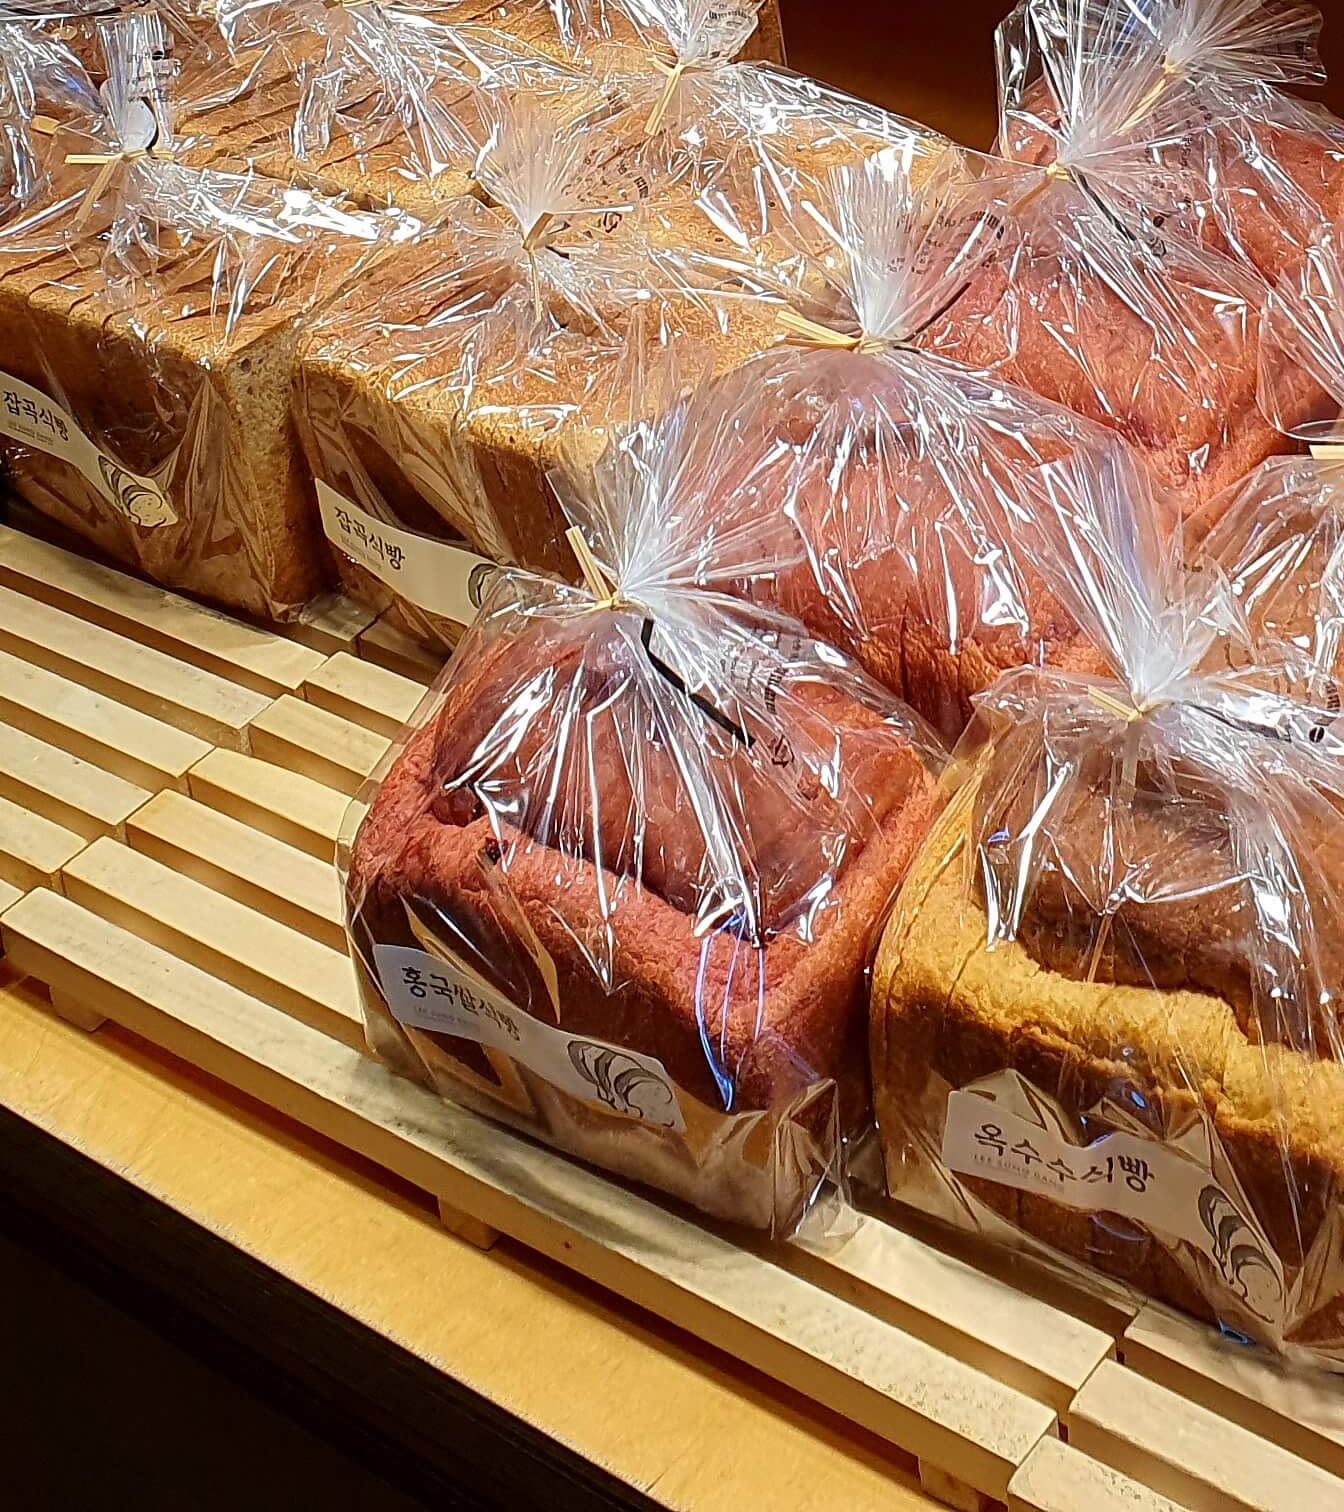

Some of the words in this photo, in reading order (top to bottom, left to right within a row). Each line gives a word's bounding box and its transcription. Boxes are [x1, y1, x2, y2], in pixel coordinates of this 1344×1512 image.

[2, 388, 70, 443] 잡곡식빵
[333, 506, 407, 571] 잡곡식빵
[400, 965, 522, 1042] 홍국쌀식빵
[974, 1122, 1156, 1194] 옥수수식빵
